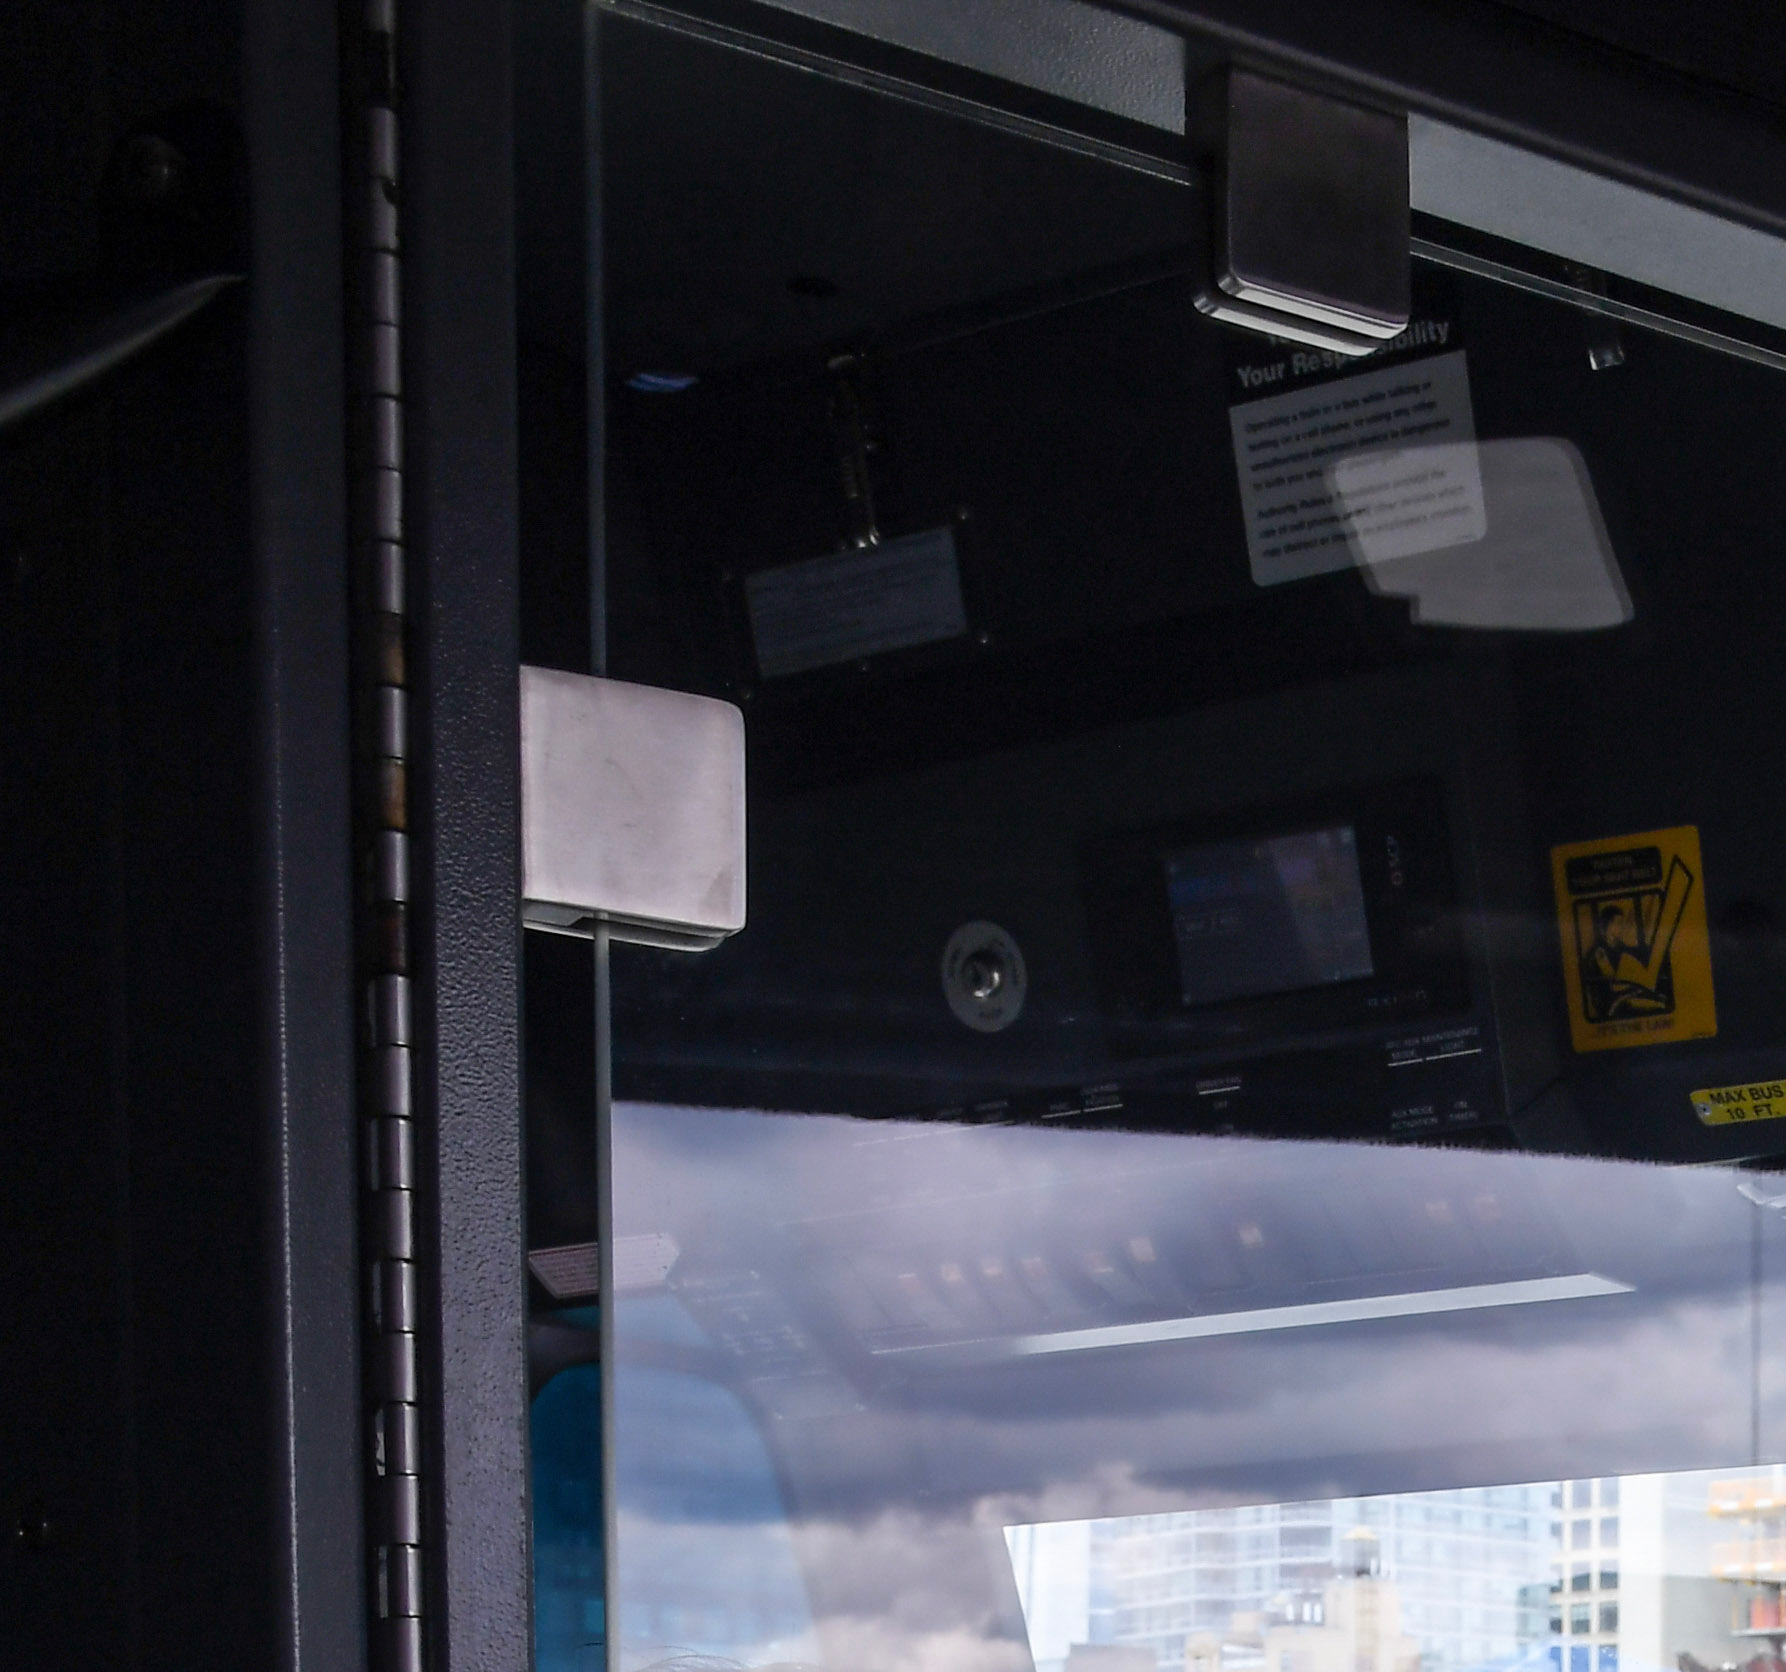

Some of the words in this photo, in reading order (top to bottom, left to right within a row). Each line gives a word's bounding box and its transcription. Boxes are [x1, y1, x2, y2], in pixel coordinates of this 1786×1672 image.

[1236, 365, 1286, 388] Your
[1709, 1086, 1747, 1106] MAX
[1748, 1082, 1784, 1101] BUS
[1726, 1106, 1745, 1120] 10
[1754, 1103, 1782, 1118] FT.
